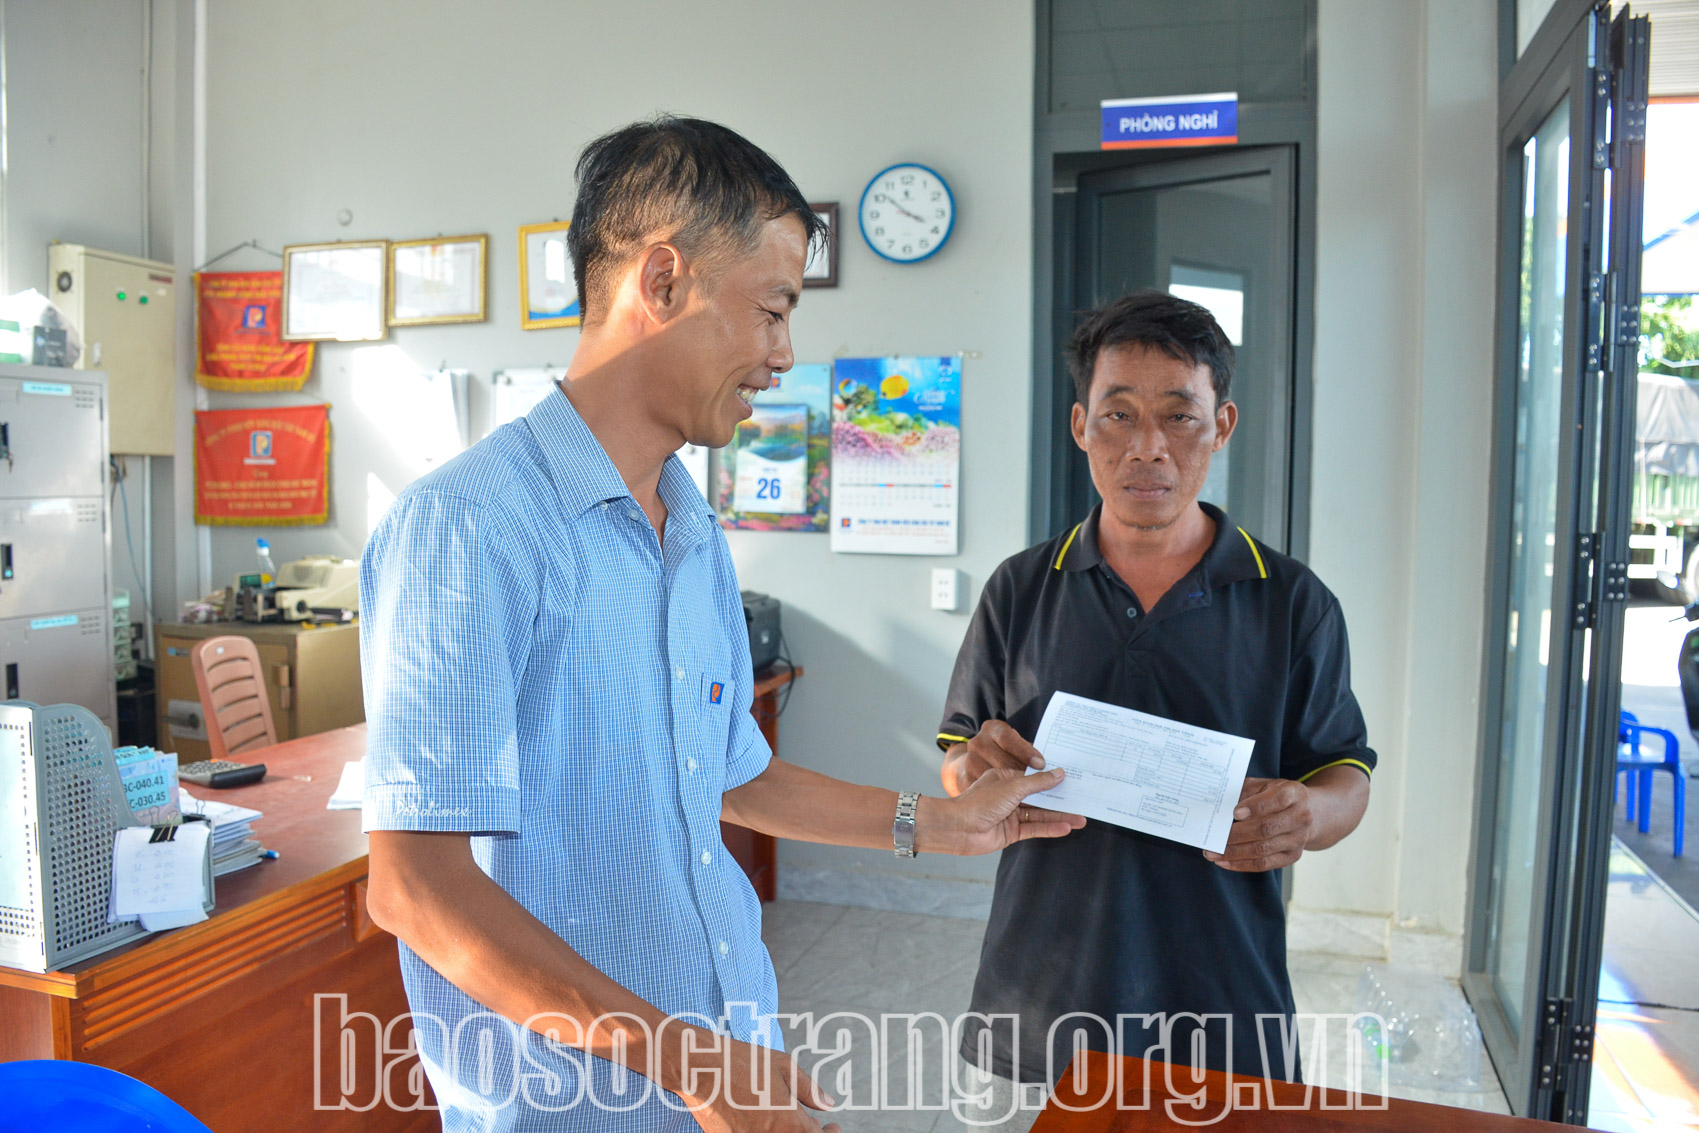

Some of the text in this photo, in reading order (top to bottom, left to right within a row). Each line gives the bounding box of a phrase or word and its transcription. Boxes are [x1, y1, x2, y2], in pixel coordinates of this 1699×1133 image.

[1119, 110, 1219, 133] PHÒNG NGHỈ
[757, 478, 781, 499] 26
[395, 800, 472, 818] Petrolimex
